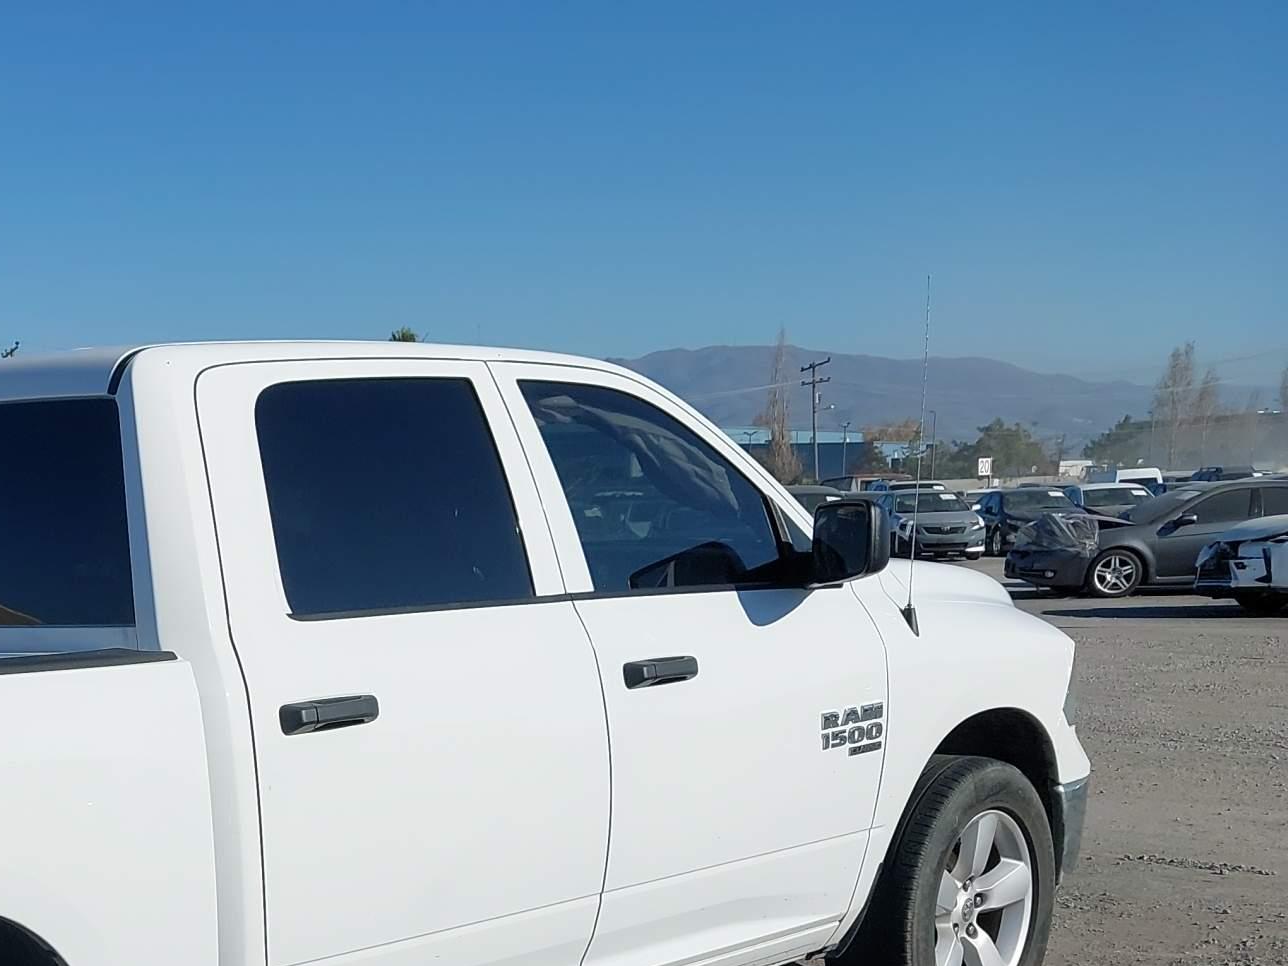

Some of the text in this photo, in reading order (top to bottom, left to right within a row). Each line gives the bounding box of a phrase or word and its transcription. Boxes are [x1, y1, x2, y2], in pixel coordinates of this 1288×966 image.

[979, 459, 990, 474] 20
[821, 702, 883, 731] RAM
[821, 721, 883, 751] 1500
